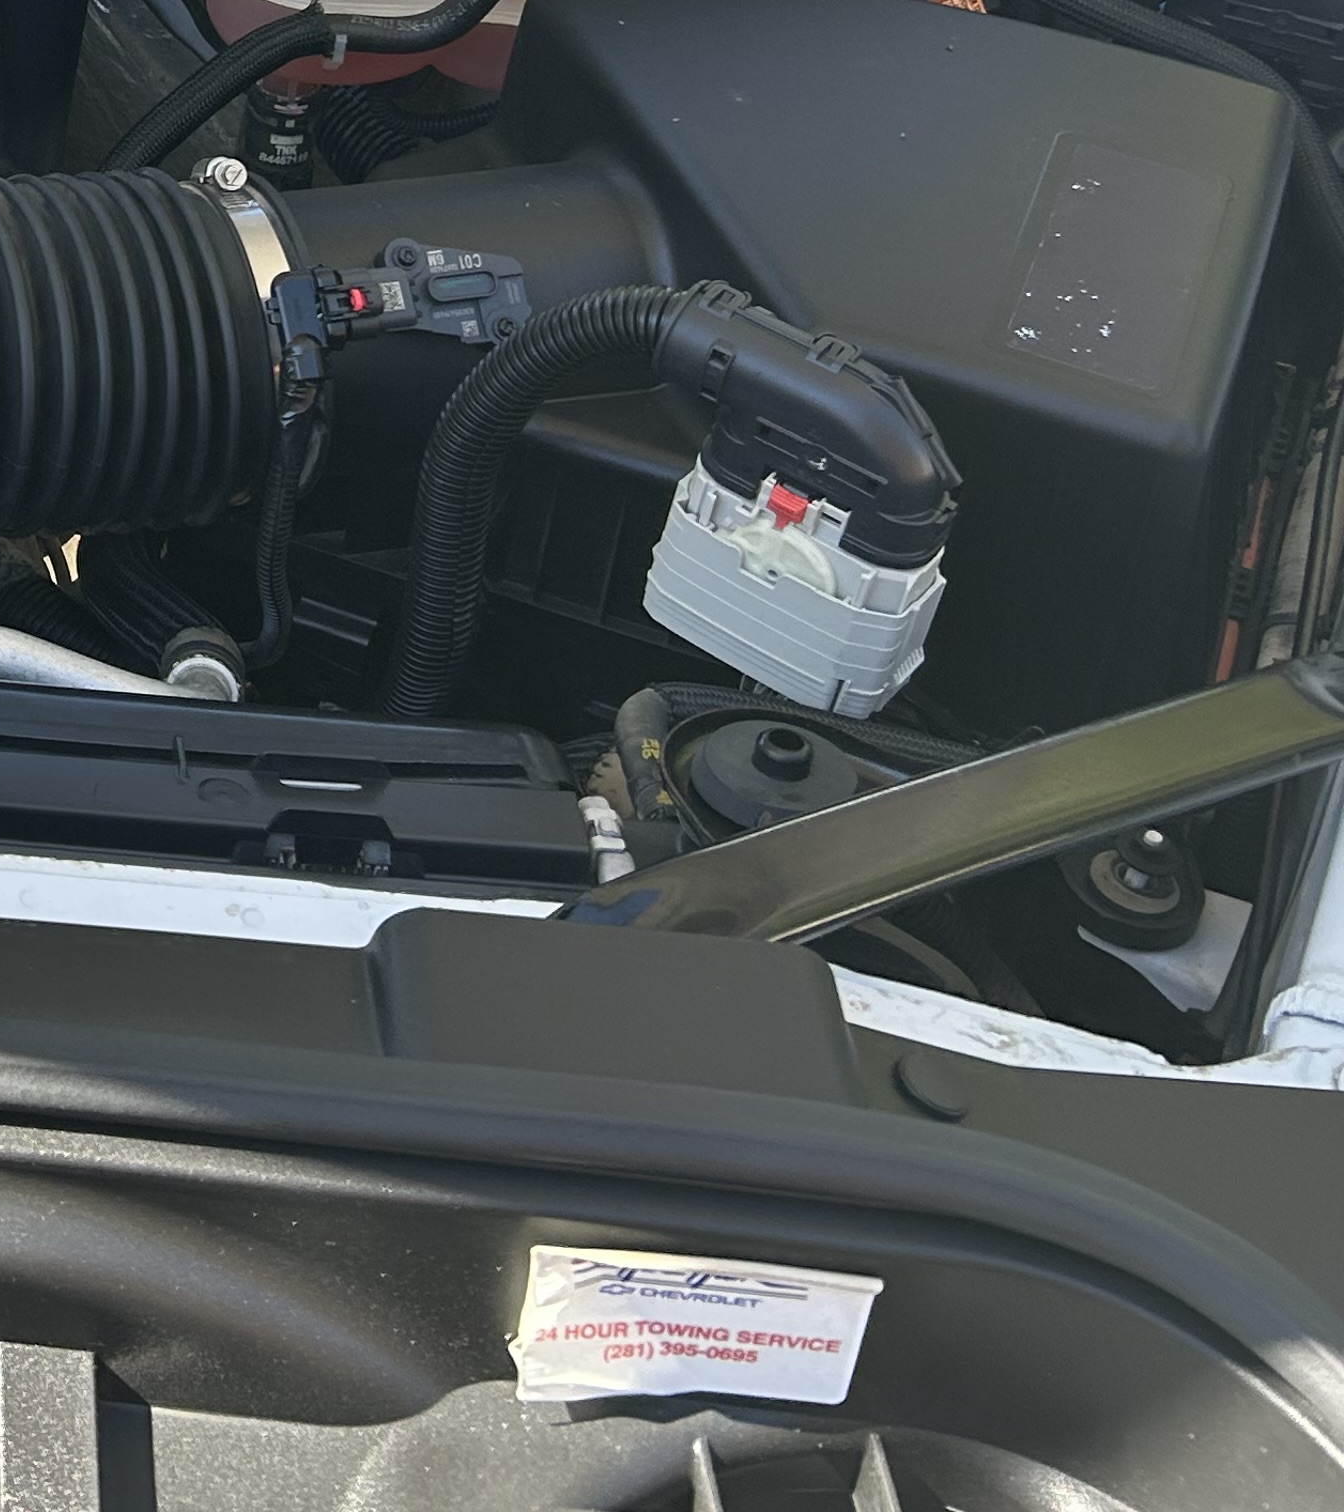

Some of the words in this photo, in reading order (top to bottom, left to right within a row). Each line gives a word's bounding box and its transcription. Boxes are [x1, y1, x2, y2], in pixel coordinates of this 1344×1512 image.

[427, 254, 445, 266] GM
[639, 1287, 762, 1308] CHEVROLET
[535, 1327, 558, 1342] 24
[564, 1321, 629, 1340] HOUR
[634, 1321, 729, 1342] TOWING
[737, 1330, 841, 1353] SERVICE
[604, 1342, 654, 1363] (281)
[660, 1341, 758, 1363] 395-0695
